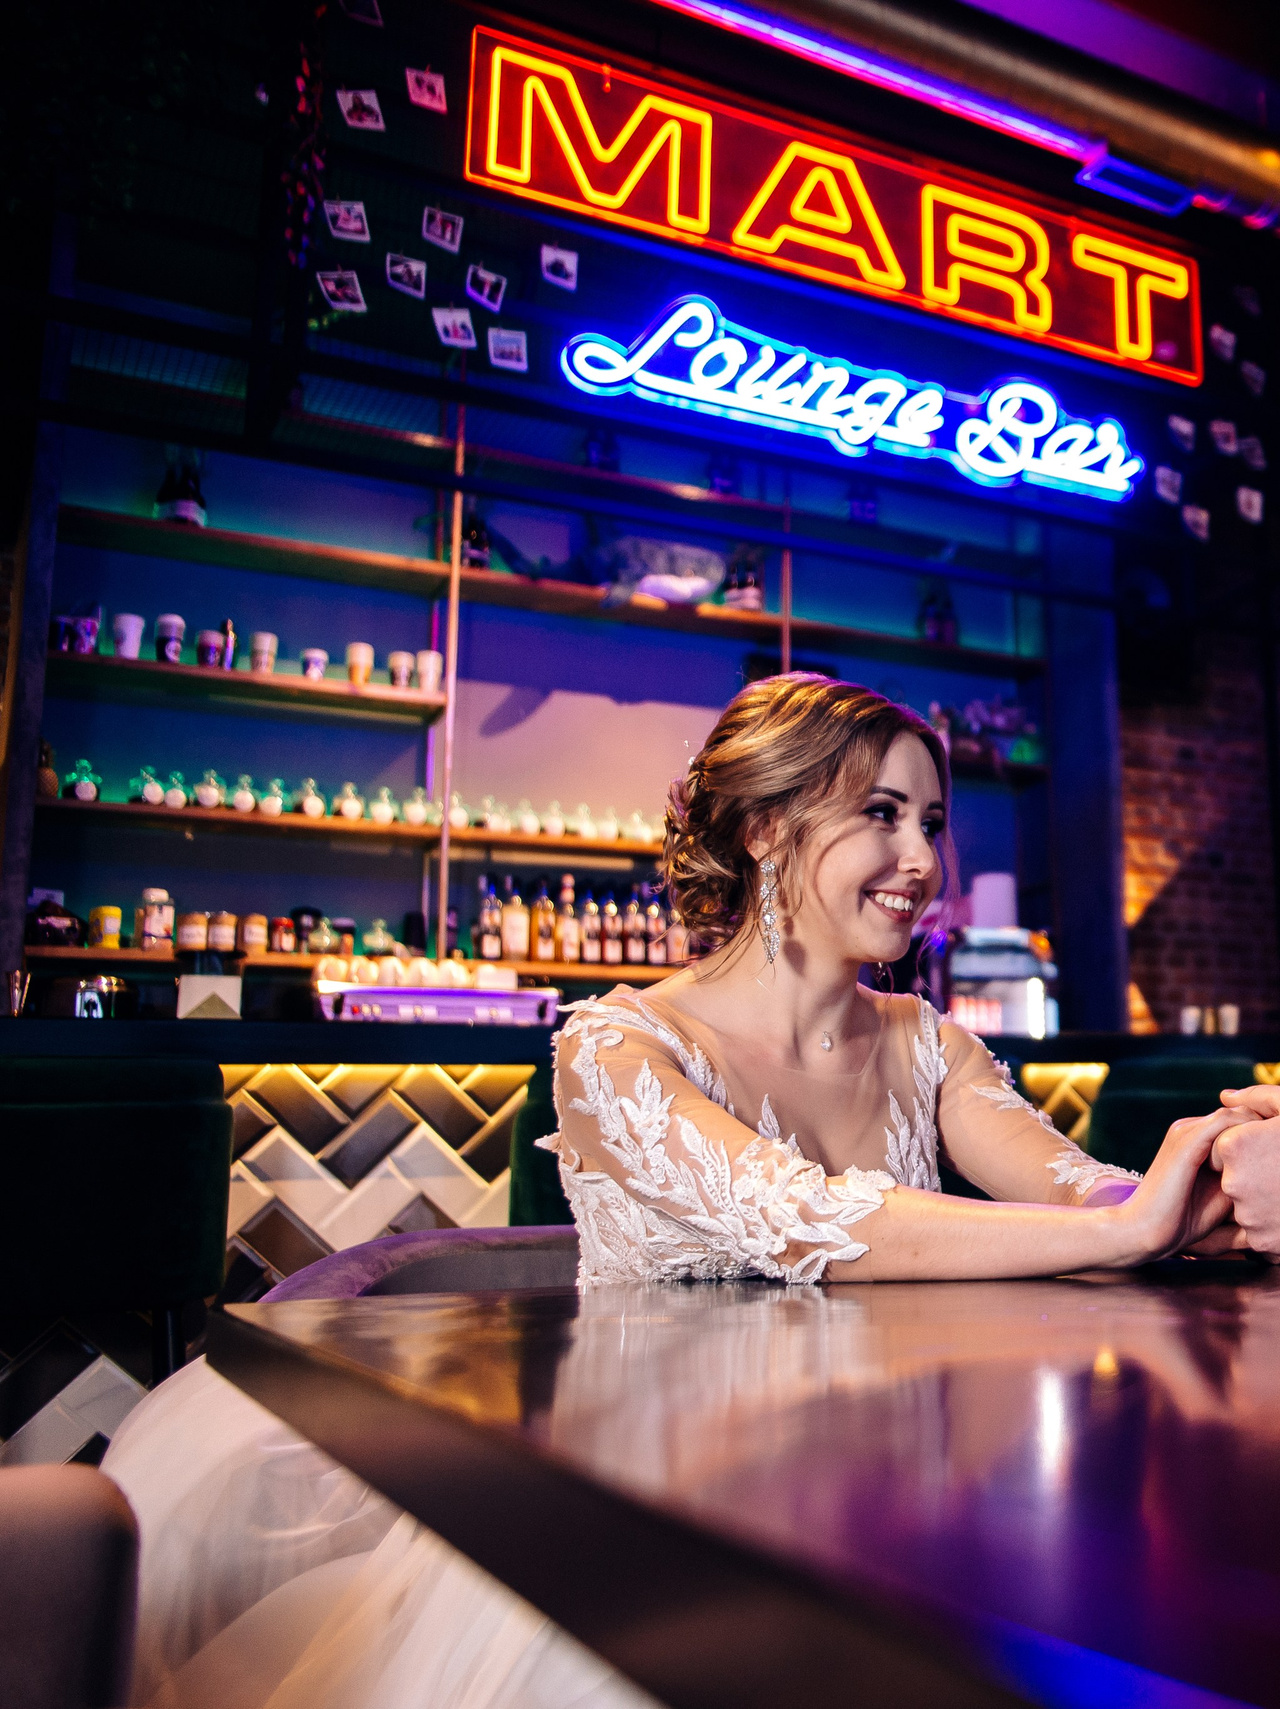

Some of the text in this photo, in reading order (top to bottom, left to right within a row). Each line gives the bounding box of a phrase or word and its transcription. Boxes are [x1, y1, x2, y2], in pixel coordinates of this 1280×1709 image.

[486, 45, 1190, 362] MART
[571, 300, 1144, 493] Lounge Bar
